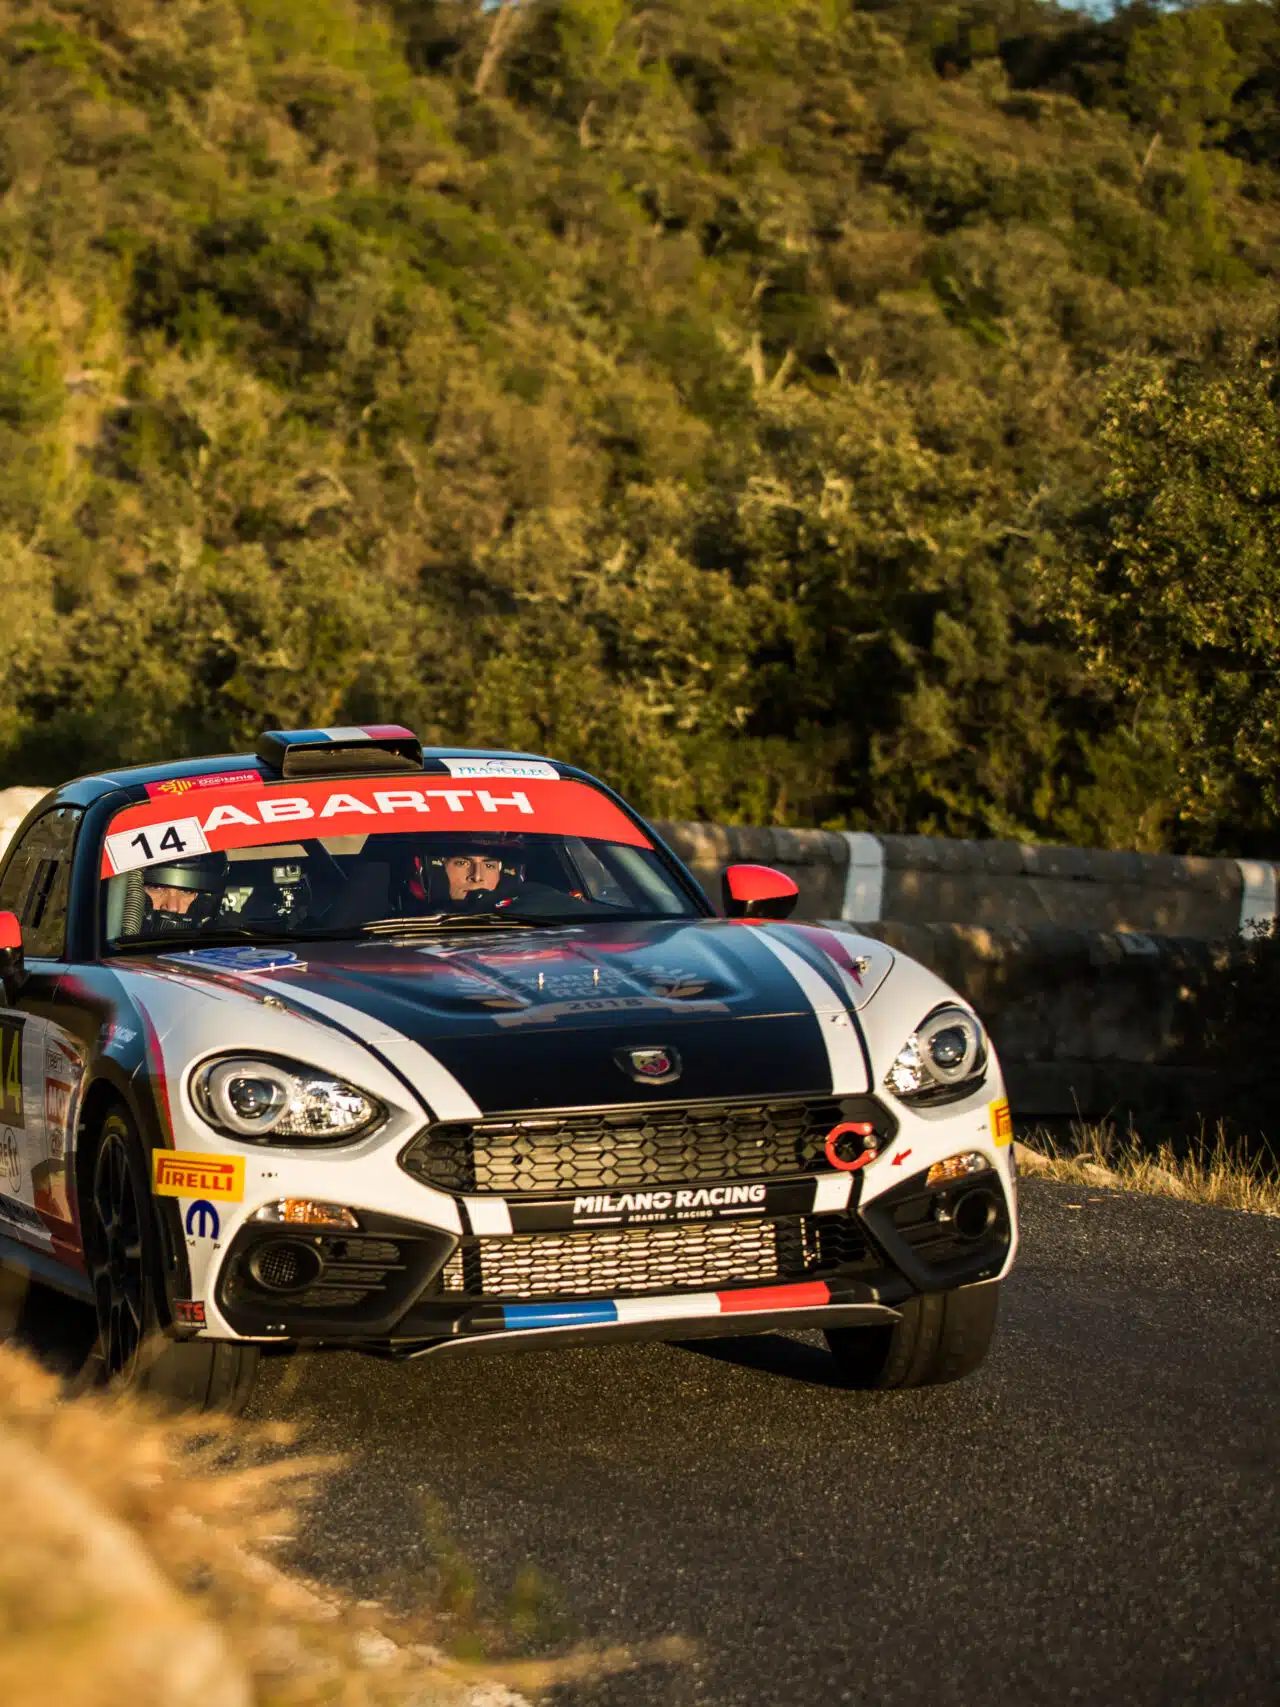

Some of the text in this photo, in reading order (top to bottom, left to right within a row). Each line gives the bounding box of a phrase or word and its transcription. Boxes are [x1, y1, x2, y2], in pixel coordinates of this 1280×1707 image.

[198, 774, 254, 786] Occitanie
[203, 790, 535, 831] ABARTH
[131, 826, 187, 860] 14
[156, 1158, 235, 1191] PIRELLI
[573, 1184, 766, 1213] MILANO RACING
[628, 1210, 713, 1222] ABARTH RACING
